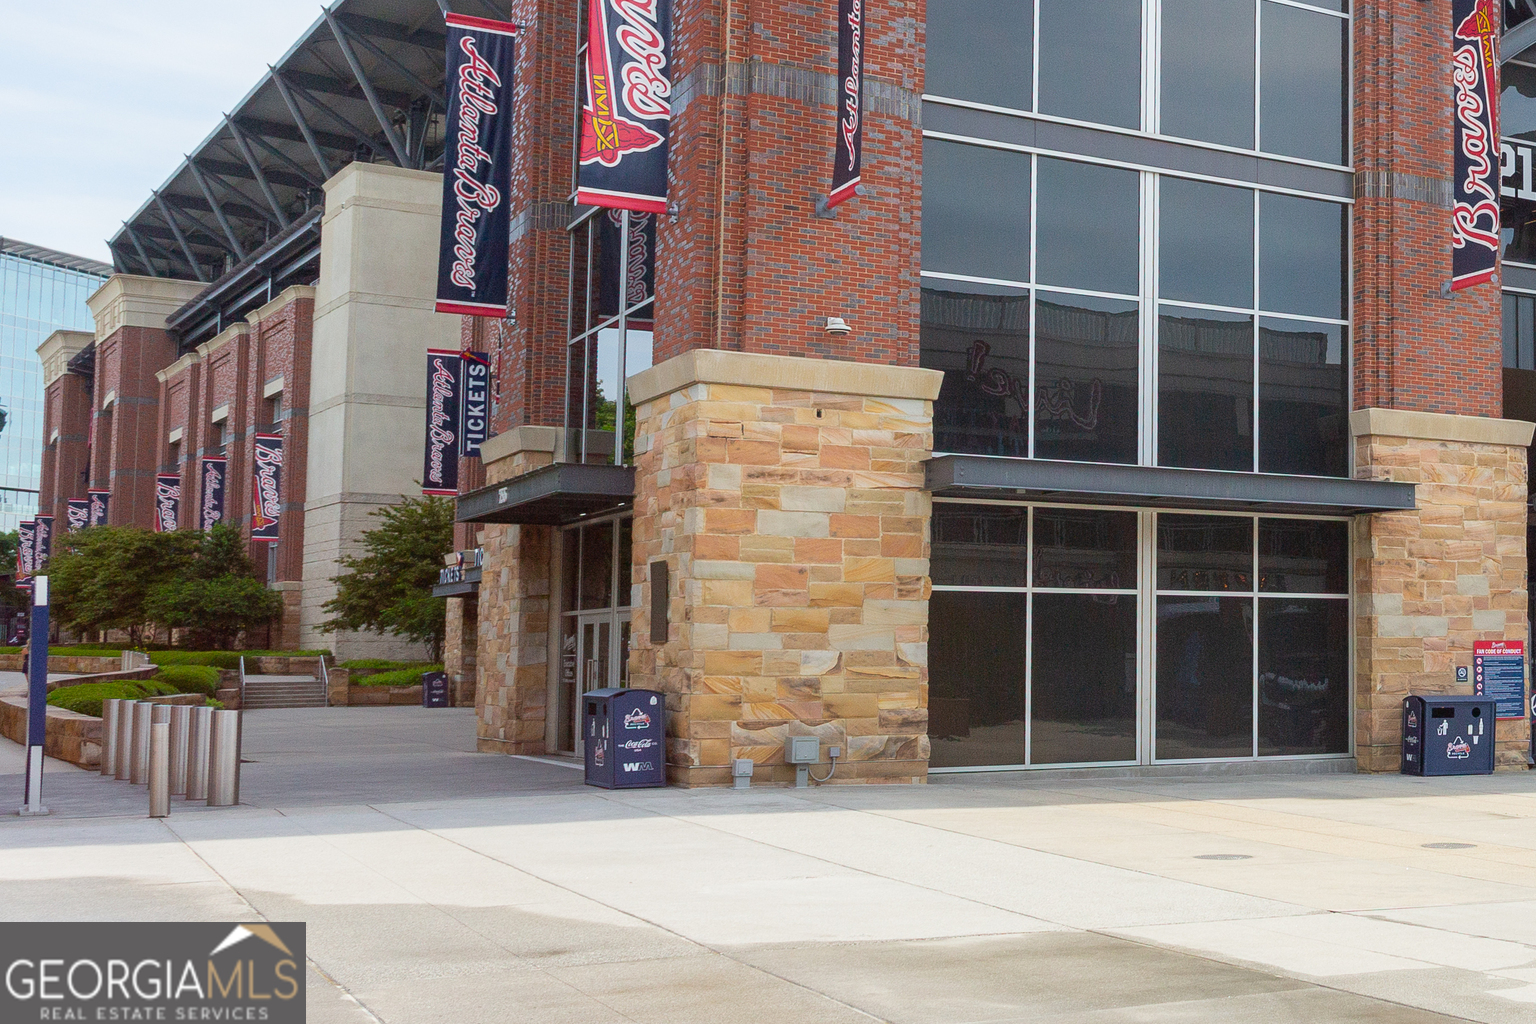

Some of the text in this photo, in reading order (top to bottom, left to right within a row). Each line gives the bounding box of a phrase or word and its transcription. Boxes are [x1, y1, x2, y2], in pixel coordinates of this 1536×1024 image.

[450, 36, 501, 290] Atlanta Braves
[1453, 48, 1499, 252] Braves
[1500, 142, 1536, 201] 21
[430, 358, 455, 483] Atlanta Braves
[467, 364, 486, 451] TICKETS
[255, 444, 282, 516] Braves
